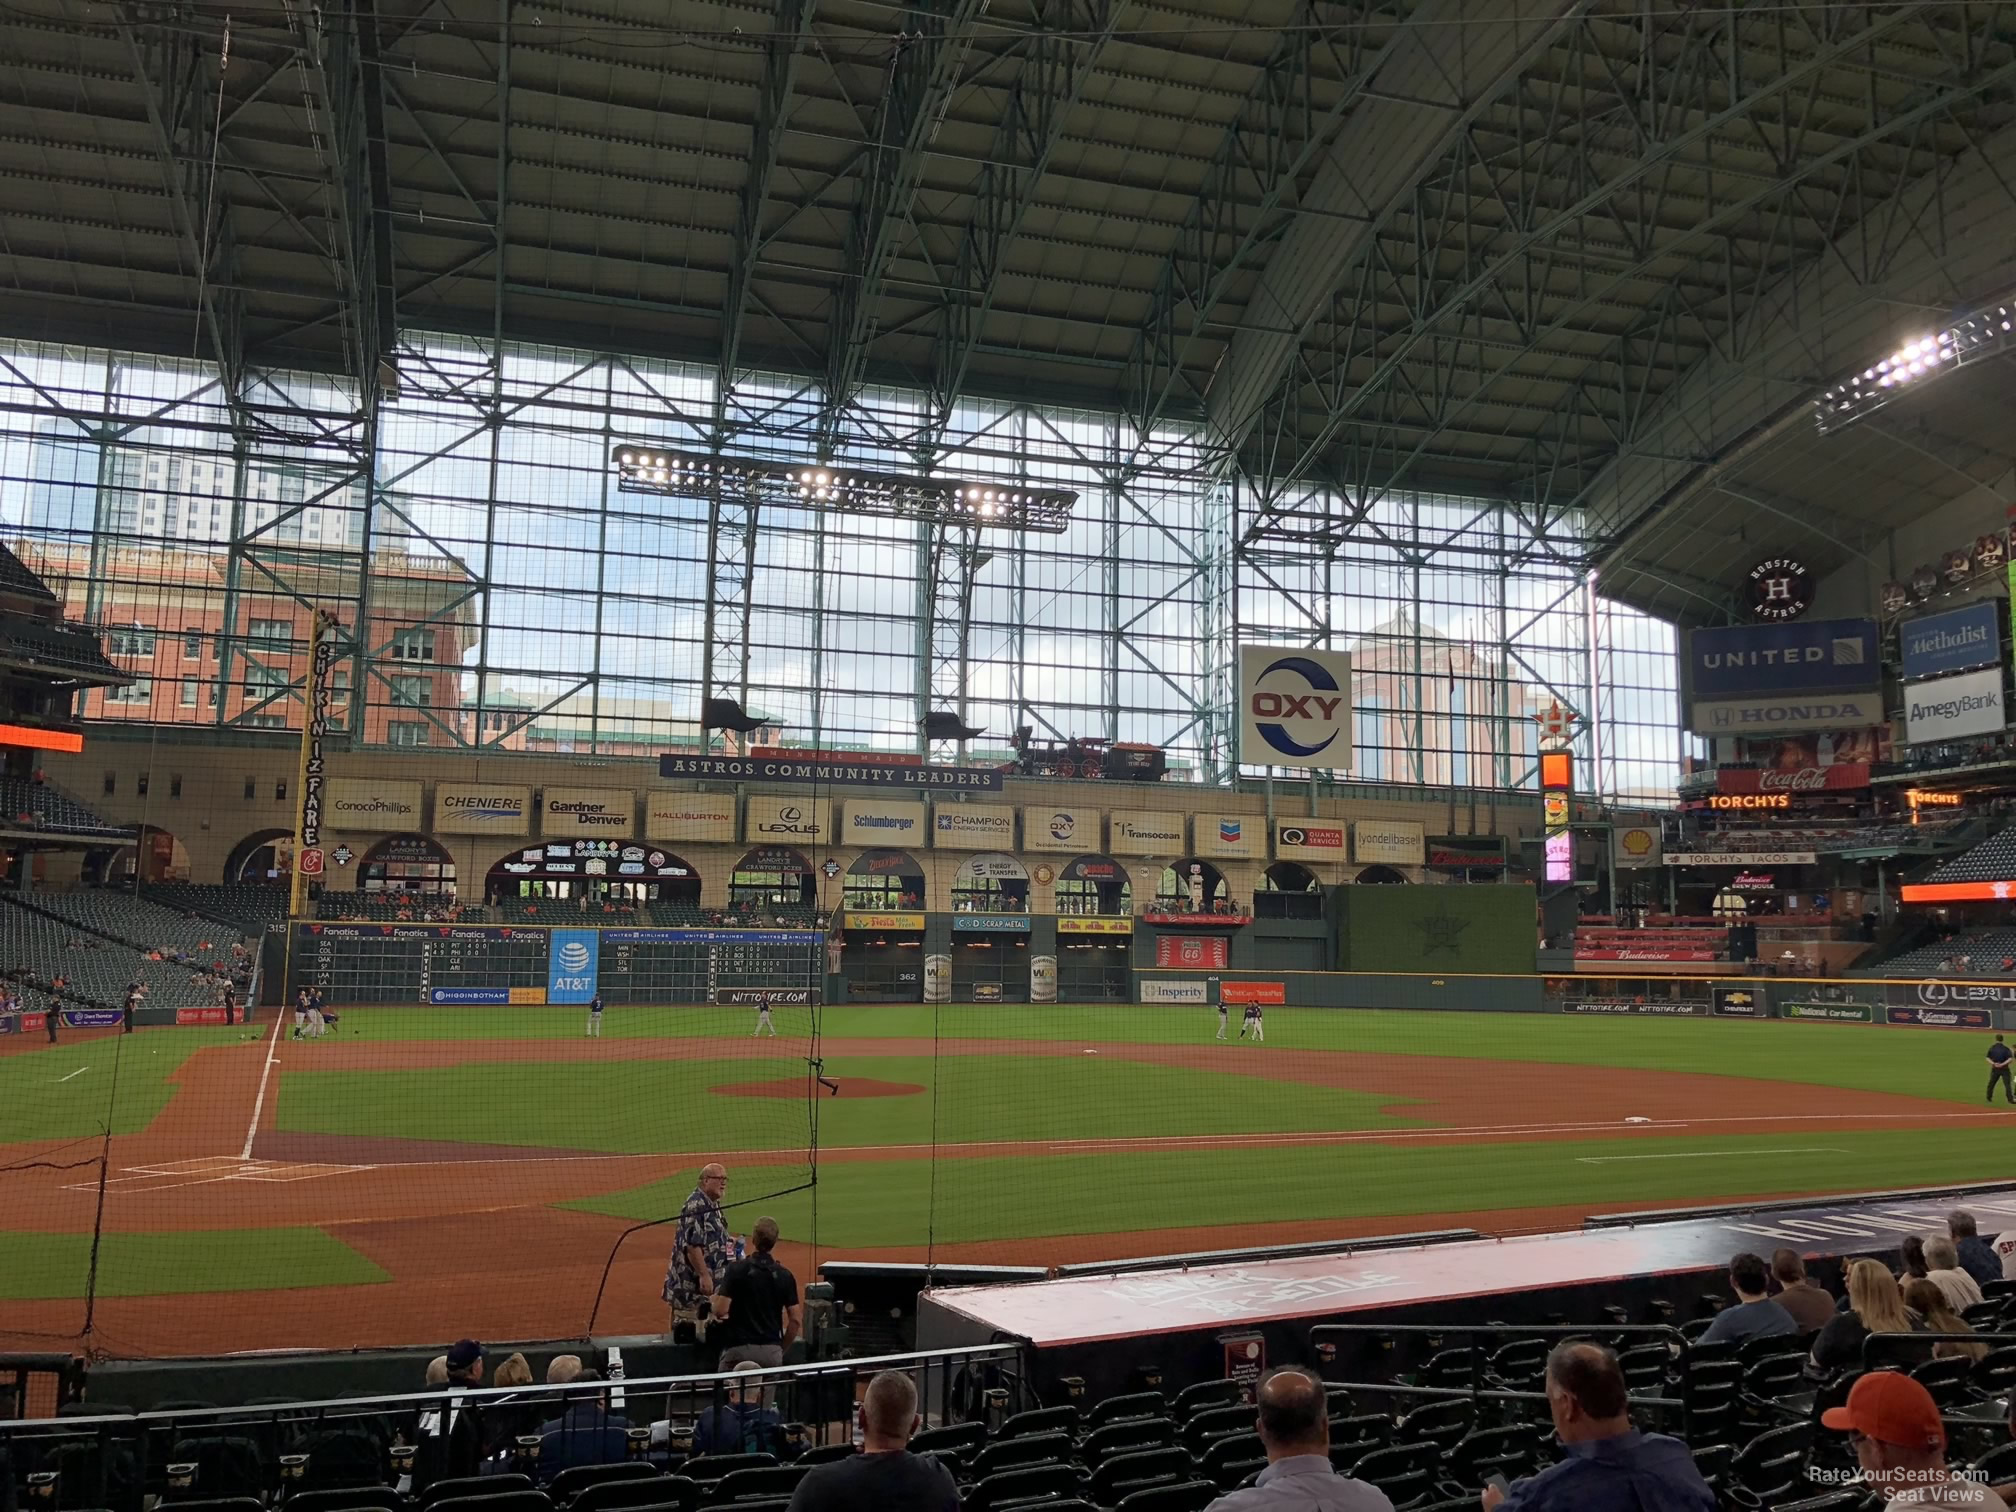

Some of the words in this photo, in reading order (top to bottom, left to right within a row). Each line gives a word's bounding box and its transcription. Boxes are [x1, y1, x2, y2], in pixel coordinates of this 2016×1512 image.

[1750, 559, 1806, 579] HOUSTON
[1765, 578, 1790, 600] H
[1754, 600, 1804, 618] ASTROS
[1909, 625, 1988, 656] Methodist
[1704, 648, 1825, 669] UNITED
[1252, 692, 1342, 720] OXY
[1910, 691, 1998, 723] AmegyBank
[1739, 704, 1864, 722] HONDA
[764, 764, 894, 782] COMMUNITY
[904, 771, 992, 785] LEADERS
[335, 800, 412, 814] ConocoPhillips
[444, 796, 522, 810] CHENIERE
[550, 800, 605, 813] Gardner
[305, 778, 321, 844] FARE
[653, 812, 729, 821] HALLIBURTON
[578, 813, 627, 826] Denver
[854, 814, 914, 830] Schlumberger
[953, 816, 1010, 826] CHAMPION
[758, 824, 820, 834] LEXUS
[1127, 829, 1180, 840] Transocean
[268, 924, 286, 933] 315
[870, 917, 895, 927] Fiesta
[982, 920, 1004, 928] SCRAP
[1004, 920, 1025, 928] METAL
[324, 927, 359, 936] Fanatics
[394, 928, 428, 937] Fanatics
[452, 929, 485, 938] Fanatics
[512, 931, 545, 939] Fanatics
[1184, 950, 1198, 958] 66
[1616, 950, 1670, 960] Budweiser
[422, 944, 430, 999] NATIONAL
[554, 978, 592, 990] AT&T
[732, 991, 808, 1002] NITTOIRE.COM
[1158, 986, 1202, 998] Insperity
[1799, 1007, 1827, 1016] National
